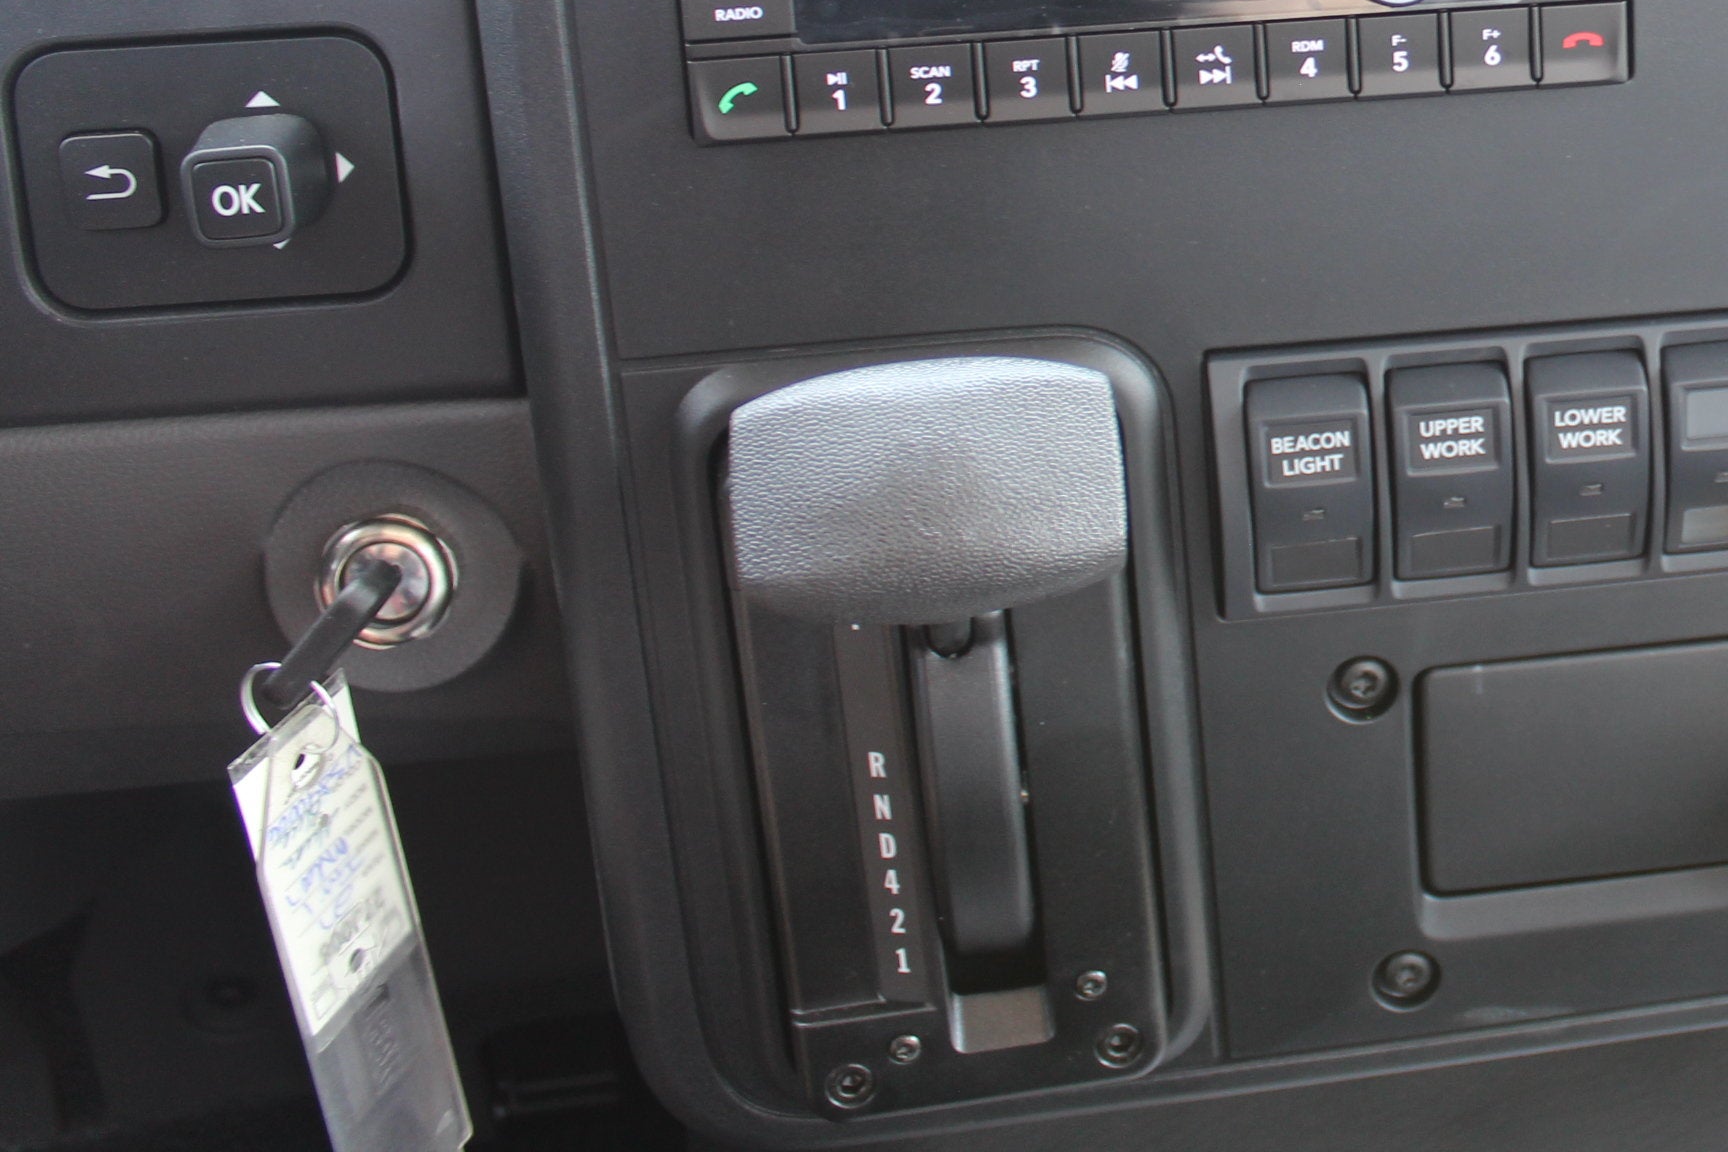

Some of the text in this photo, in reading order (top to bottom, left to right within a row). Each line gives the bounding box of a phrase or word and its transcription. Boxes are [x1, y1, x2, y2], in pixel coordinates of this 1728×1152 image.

[715, 7, 763, 21] RADIO
[1392, 35, 1406, 46] F-
[1483, 29, 1500, 40] F+
[1292, 40, 1324, 52] RDM
[1485, 45, 1501, 65] 6
[910, 66, 951, 78] SCAN
[1013, 60, 1039, 71] RPT
[1300, 57, 1318, 77] 4
[1393, 51, 1409, 71] 5
[925, 83, 942, 104] 2
[1020, 76, 1037, 97] 3
[832, 90, 846, 110] 1
[212, 184, 264, 216] OK
[1420, 415, 1484, 440] UPPER
[1555, 406, 1626, 428] LOWER
[1271, 431, 1350, 455] BEACON
[1421, 437, 1485, 459] WORK
[1559, 426, 1622, 450] WORK
[1282, 452, 1343, 477] LIGHT
[868, 752, 885, 777] R
[874, 795, 891, 819] N
[879, 833, 896, 858] D
[885, 870, 900, 894] 4
[890, 909, 905, 933] 2
[896, 949, 910, 973] 1
